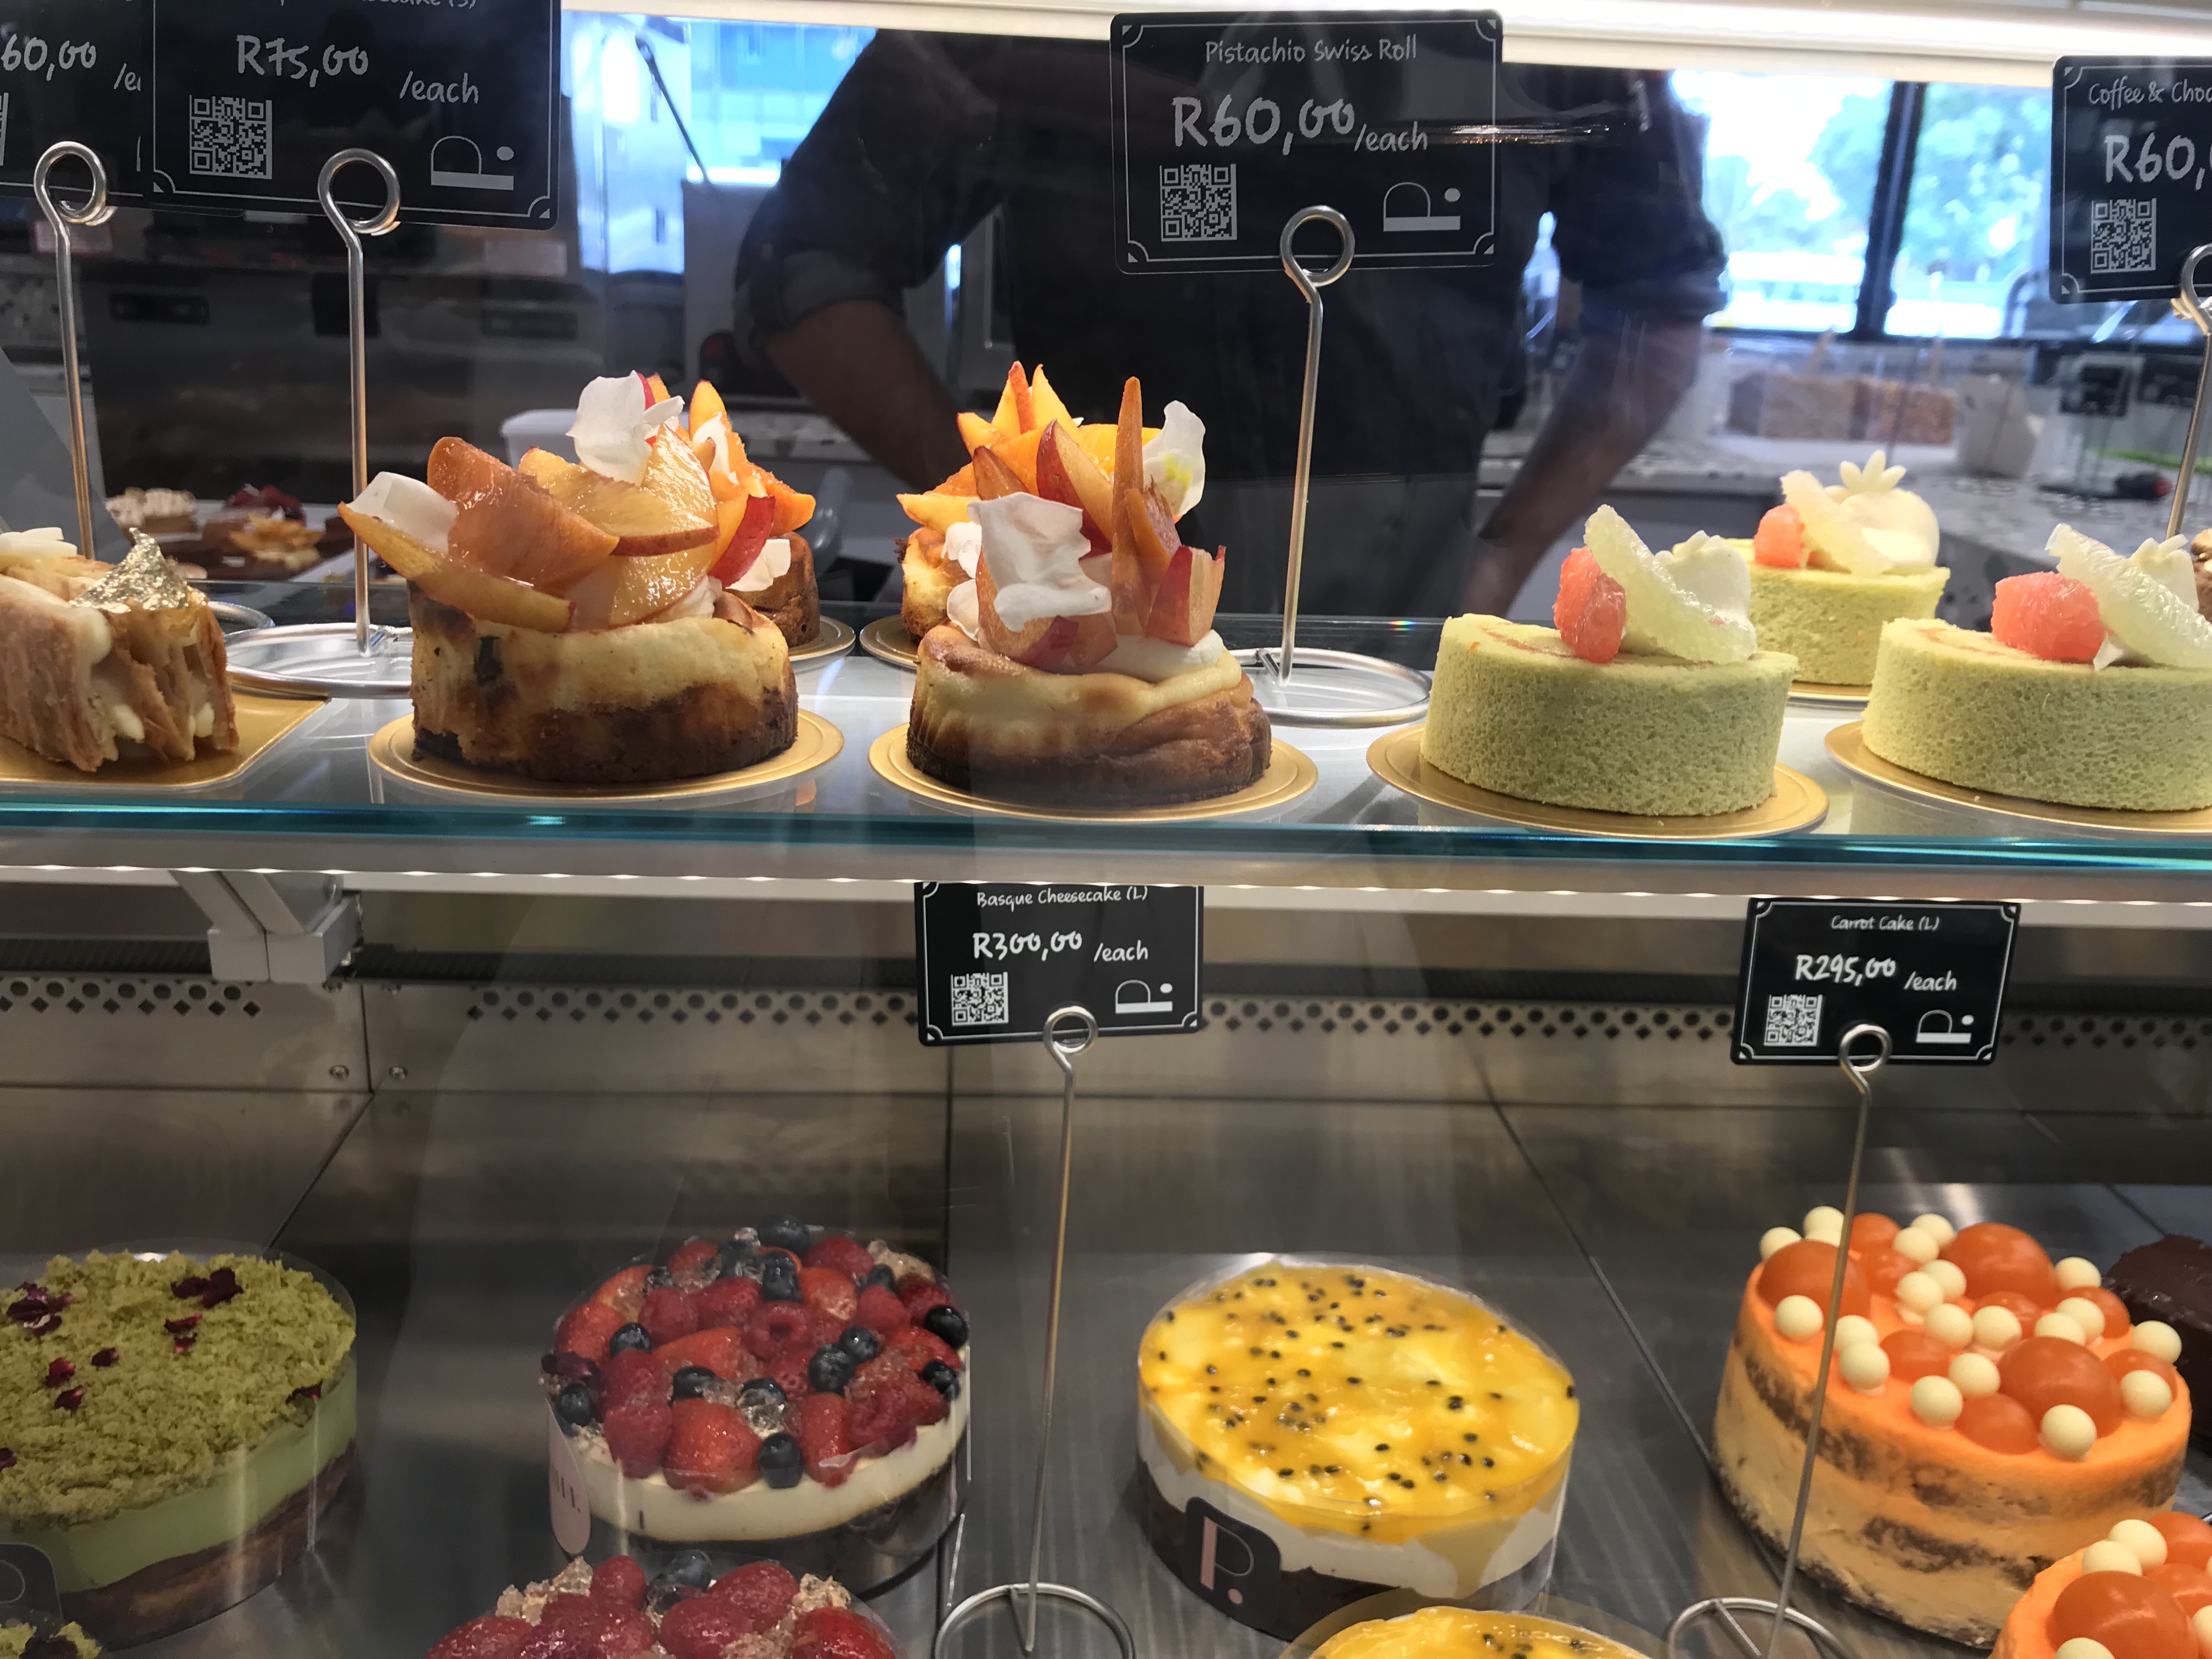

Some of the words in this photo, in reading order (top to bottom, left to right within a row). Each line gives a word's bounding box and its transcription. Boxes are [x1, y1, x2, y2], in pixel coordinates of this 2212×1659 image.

[1205, 37, 1306, 64] Pistachio
[1314, 40, 1372, 63] Swiss
[1379, 34, 1417, 61] Roll
[236, 35, 369, 88] R75,00
[399, 71, 479, 104] /each
[2089, 75, 2145, 111] Coffee
[2148, 81, 2165, 103] &
[1171, 94, 1355, 155] R60,00
[1354, 121, 1427, 152] /each
[2103, 132, 2212, 191] R60,
[977, 891, 1034, 912] Basque
[1038, 885, 1122, 904] Cheesecake
[1126, 885, 1148, 901] (L)
[1831, 915, 1875, 930] Carrot
[1879, 914, 1914, 931] Cake
[1918, 916, 1940, 932] (L)
[973, 930, 1082, 961] R300,00
[1093, 940, 1149, 962] /each
[1795, 953, 1896, 987] R295,00
[1904, 970, 1957, 991] /each
